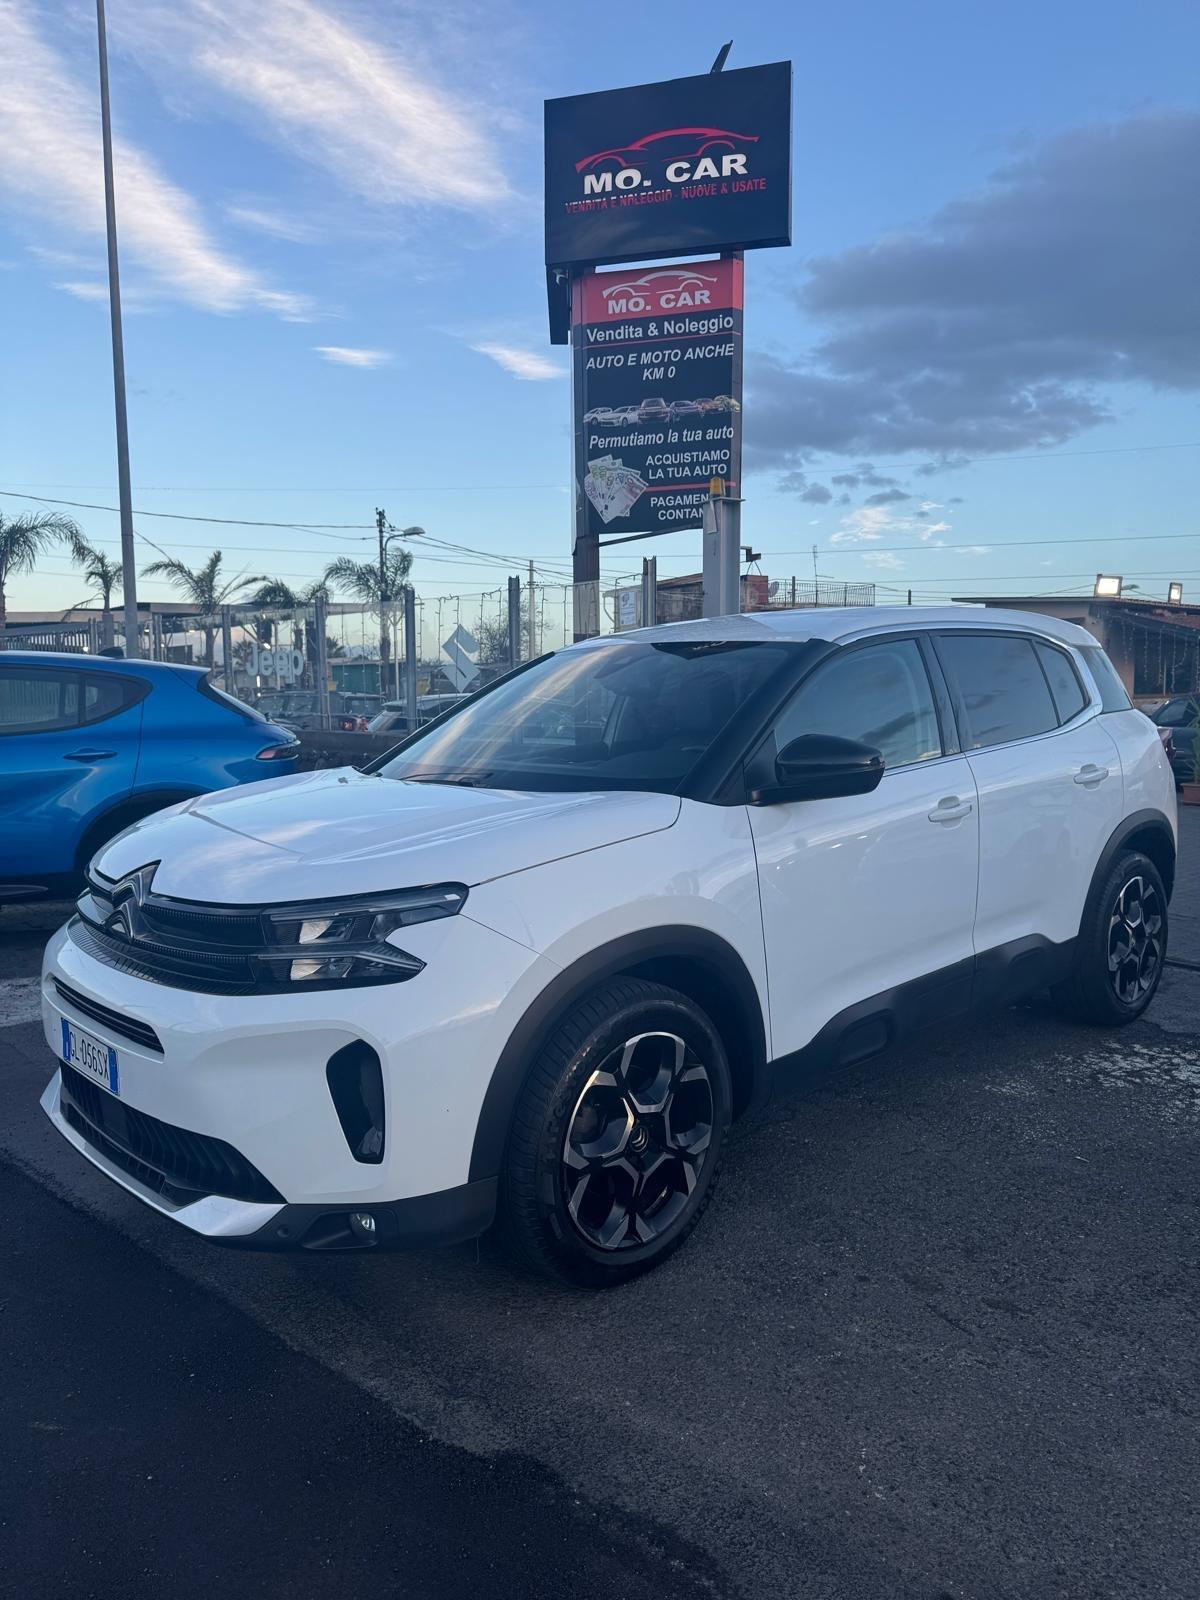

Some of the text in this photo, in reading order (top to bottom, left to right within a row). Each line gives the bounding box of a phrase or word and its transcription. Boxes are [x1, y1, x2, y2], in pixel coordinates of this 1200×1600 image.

[583, 153, 748, 194] MO. CAR
[564, 198, 608, 214] VENDITA
[611, 196, 617, 208] E
[620, 188, 673, 206] NOLEGGIO
[681, 183, 718, 199] NUOVE
[720, 182, 728, 194] &
[732, 178, 767, 193] USATE
[607, 290, 712, 314] MO. CAR
[586, 314, 734, 342] Vendita & Noleggio
[586, 344, 735, 370] AUTO E MOTO ANCHE
[642, 367, 664, 380] KM
[589, 425, 734, 450] Permutiamo la tua auto
[645, 450, 730, 466] ACQUISTIAMO
[649, 464, 728, 480] LA TUA AUTO
[246, 642, 304, 684] Jeep
